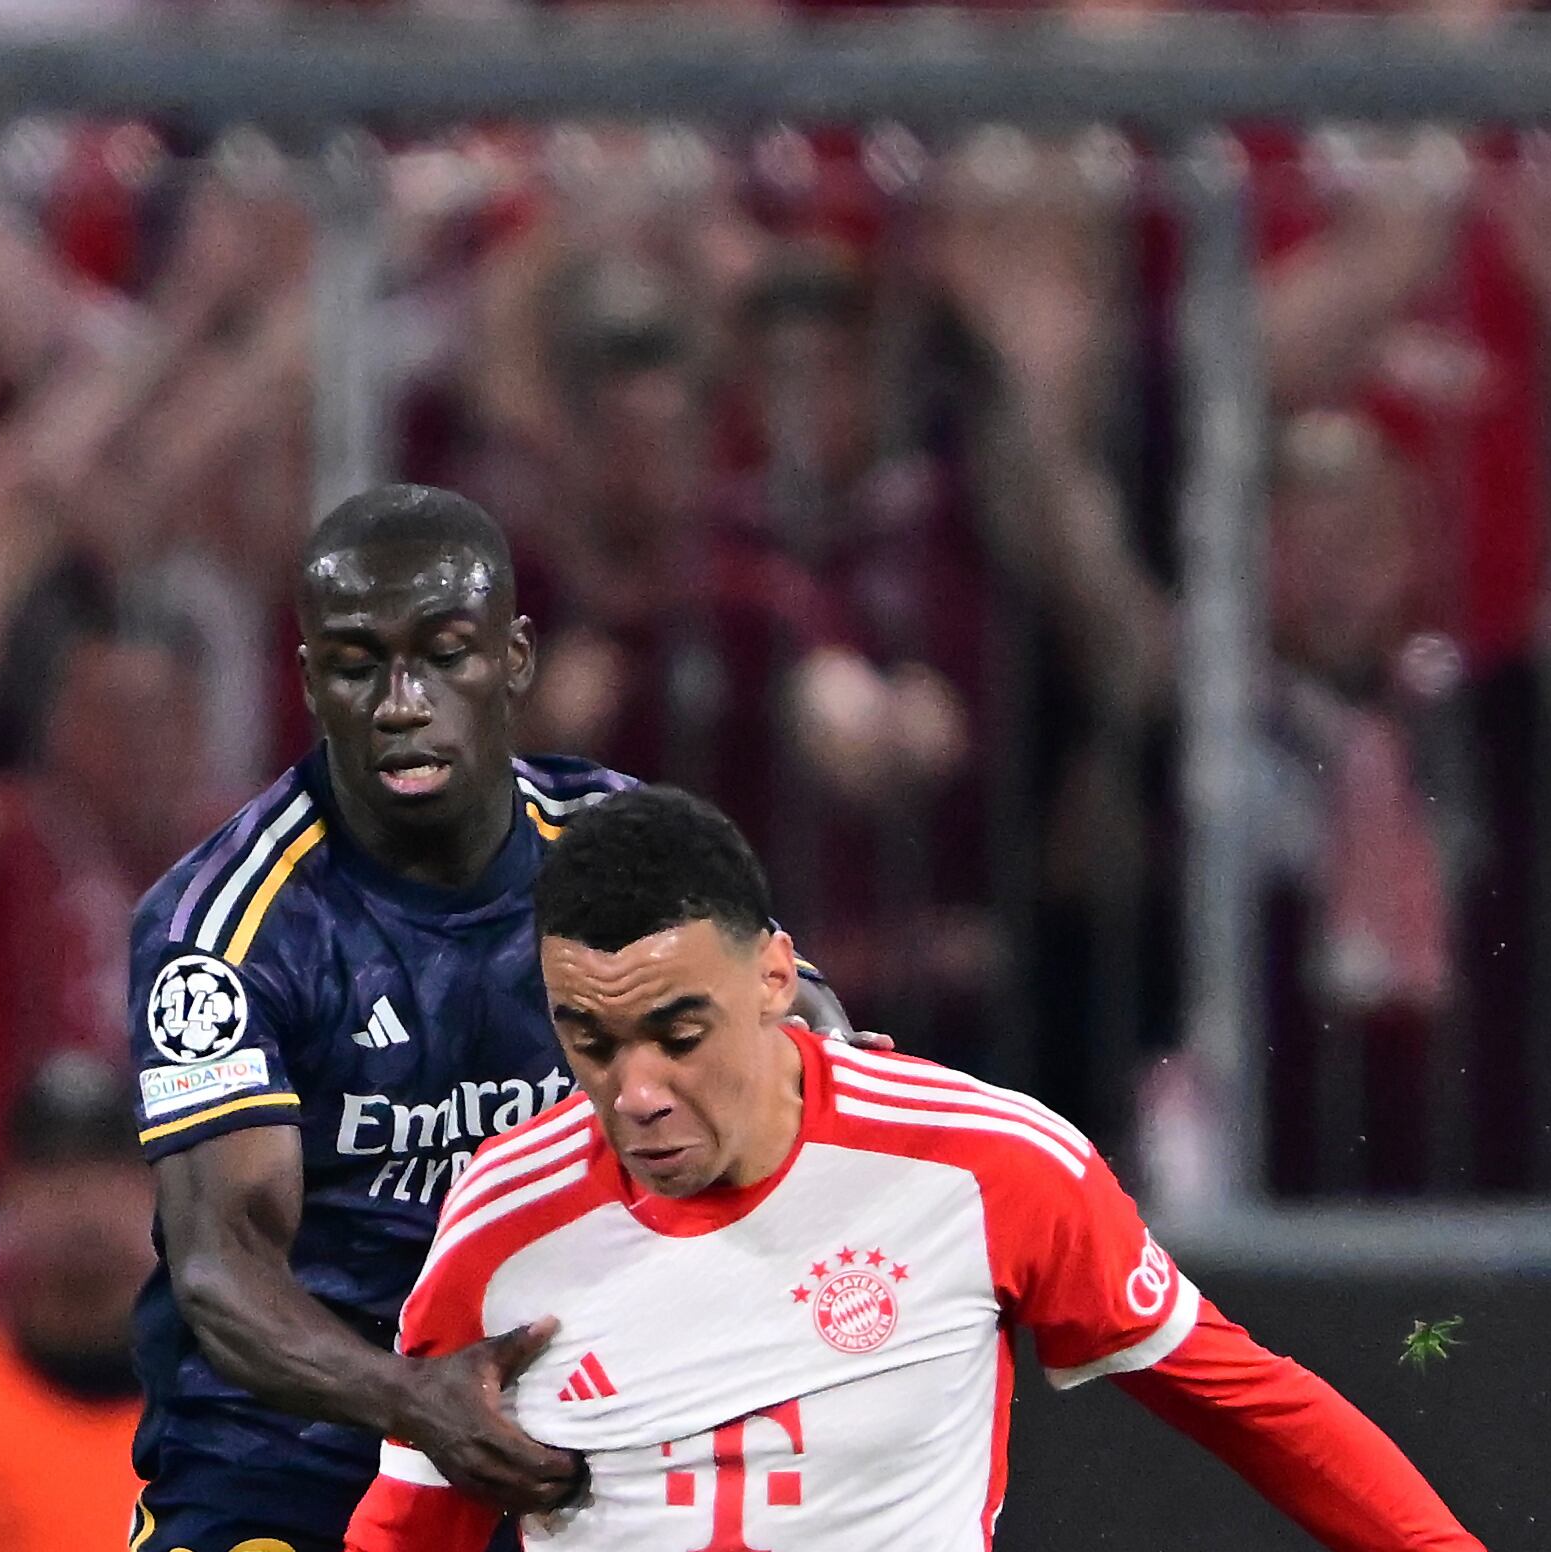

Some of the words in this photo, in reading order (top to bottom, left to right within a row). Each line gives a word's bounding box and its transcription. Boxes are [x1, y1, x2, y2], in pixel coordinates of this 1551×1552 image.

[168, 989, 219, 1031] 14
[147, 1062, 262, 1098] OUNDATION
[336, 1066, 580, 1155] Emirat
